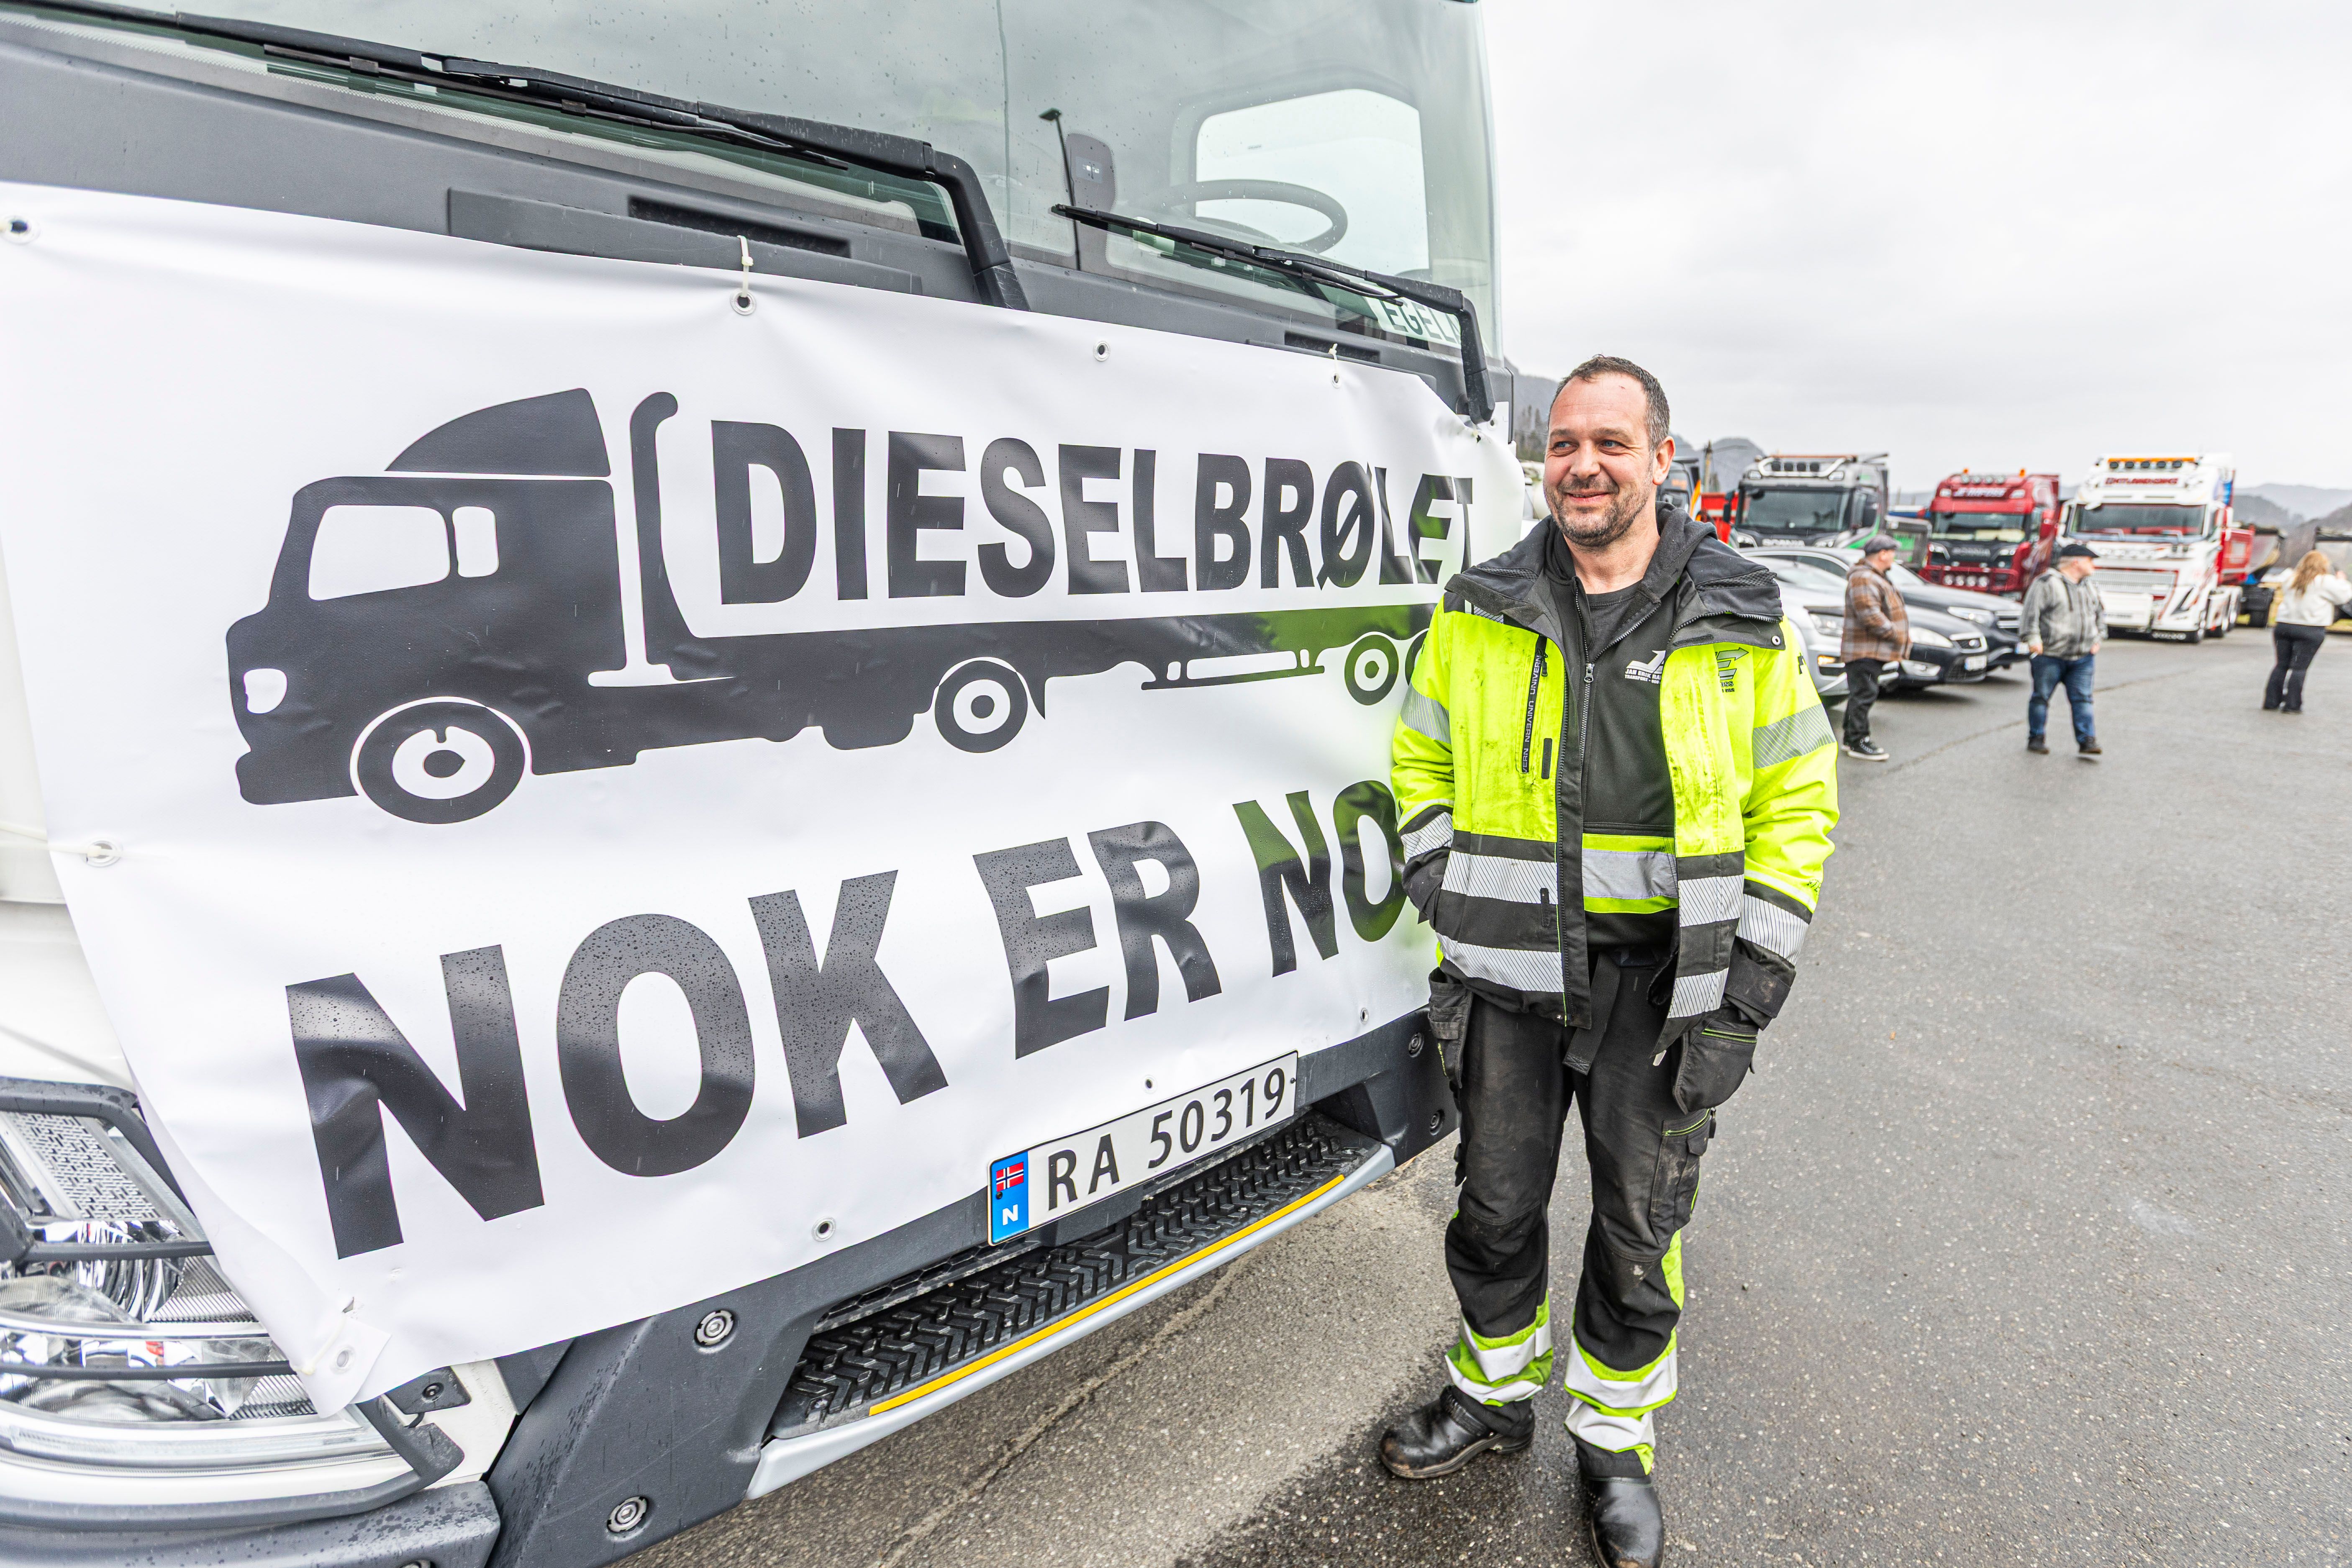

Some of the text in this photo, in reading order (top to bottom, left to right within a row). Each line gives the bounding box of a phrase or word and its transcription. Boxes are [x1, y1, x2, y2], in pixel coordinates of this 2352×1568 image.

[711, 419, 1472, 605] DIESELBRØLET
[1530, 655, 1542, 695] UNIVERN
[1525, 701, 1534, 742] UNIVERN
[285, 780, 1407, 1260] NOK ER NO
[1047, 1067, 1285, 1211] RA 50319
[1002, 1204, 1018, 1225] N
